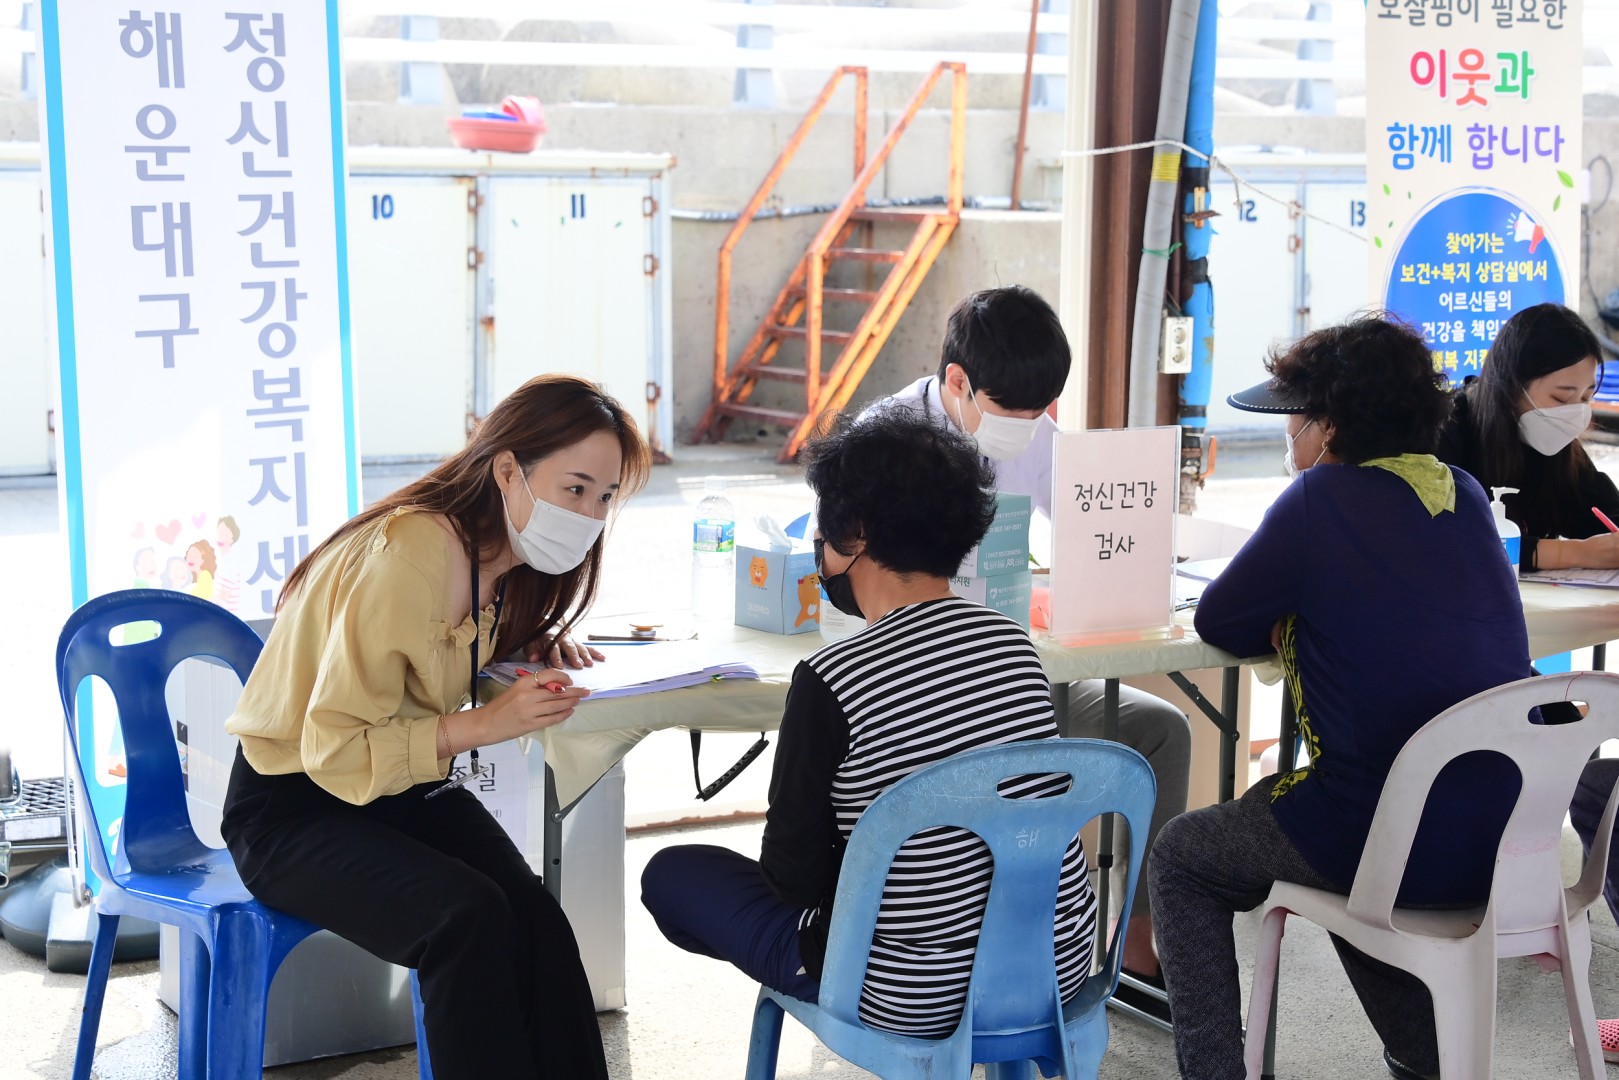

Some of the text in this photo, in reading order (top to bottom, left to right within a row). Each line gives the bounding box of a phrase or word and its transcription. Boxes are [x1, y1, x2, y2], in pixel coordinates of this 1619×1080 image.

[1491, 0, 1567, 30] 필요한
[1410, 48, 1535, 106] 이웃과
[1387, 122, 1565, 170] 함께 합니다
[119, 10, 199, 368] 해운대구
[372, 194, 394, 220] 10
[571, 194, 586, 219] 11
[1239, 200, 1258, 222] 12
[1446, 232, 1505, 255] 찾아가는
[1400, 259, 1548, 285] 보건+복지 상담실에서
[222, 12, 311, 614] 정신건강복지센
[1438, 289, 1512, 313] 어르신들의
[1421, 319, 1508, 343] 건강을 책임
[1074, 481, 1157, 513] 정신건강
[1095, 532, 1135, 561] 검사
